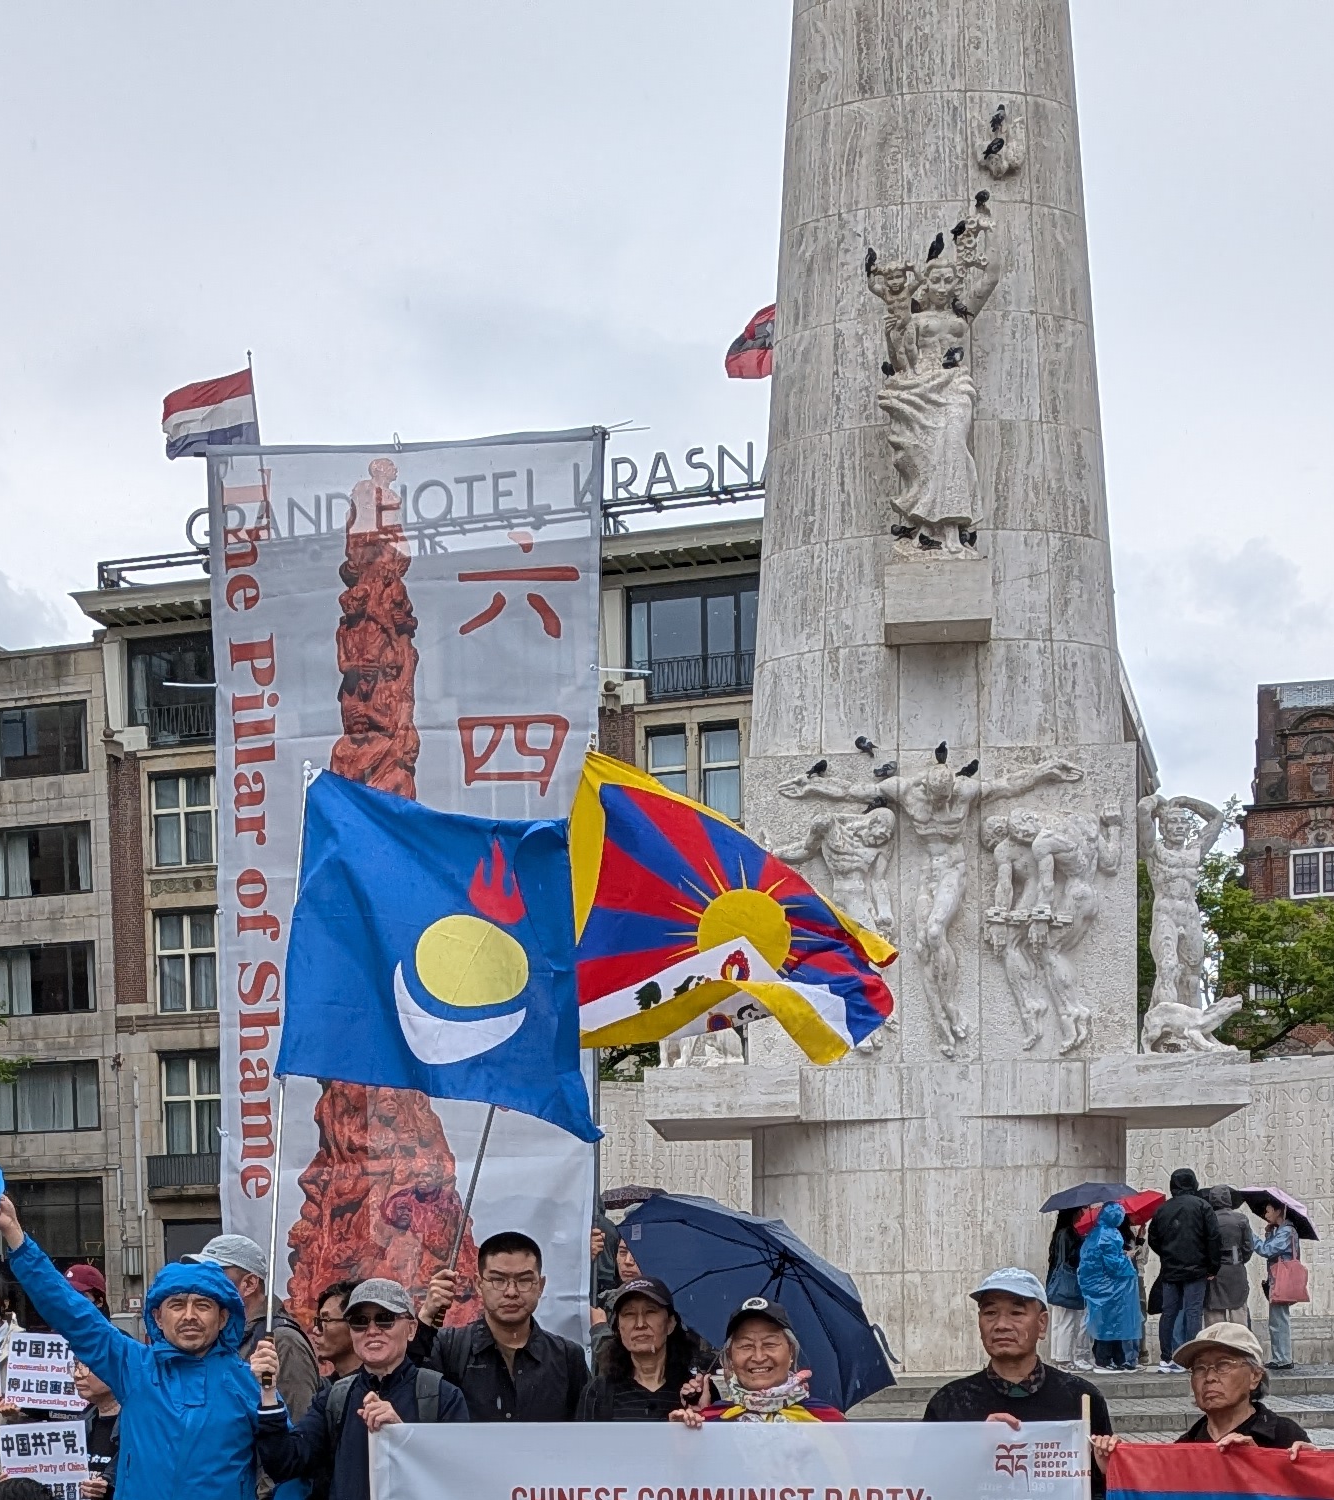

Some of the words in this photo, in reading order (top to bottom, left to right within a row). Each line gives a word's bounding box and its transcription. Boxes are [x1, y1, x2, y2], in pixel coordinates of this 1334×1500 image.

[574, 441, 765, 506] KRASN
[223, 468, 271, 612] The
[458, 532, 579, 796] 六四
[228, 632, 277, 844] Pillar
[236, 868, 279, 941] of
[239, 960, 280, 1201] Shame
[1033, 1460, 1068, 1468] GROEP
[1034, 1451, 1080, 1459] SUPPORT
